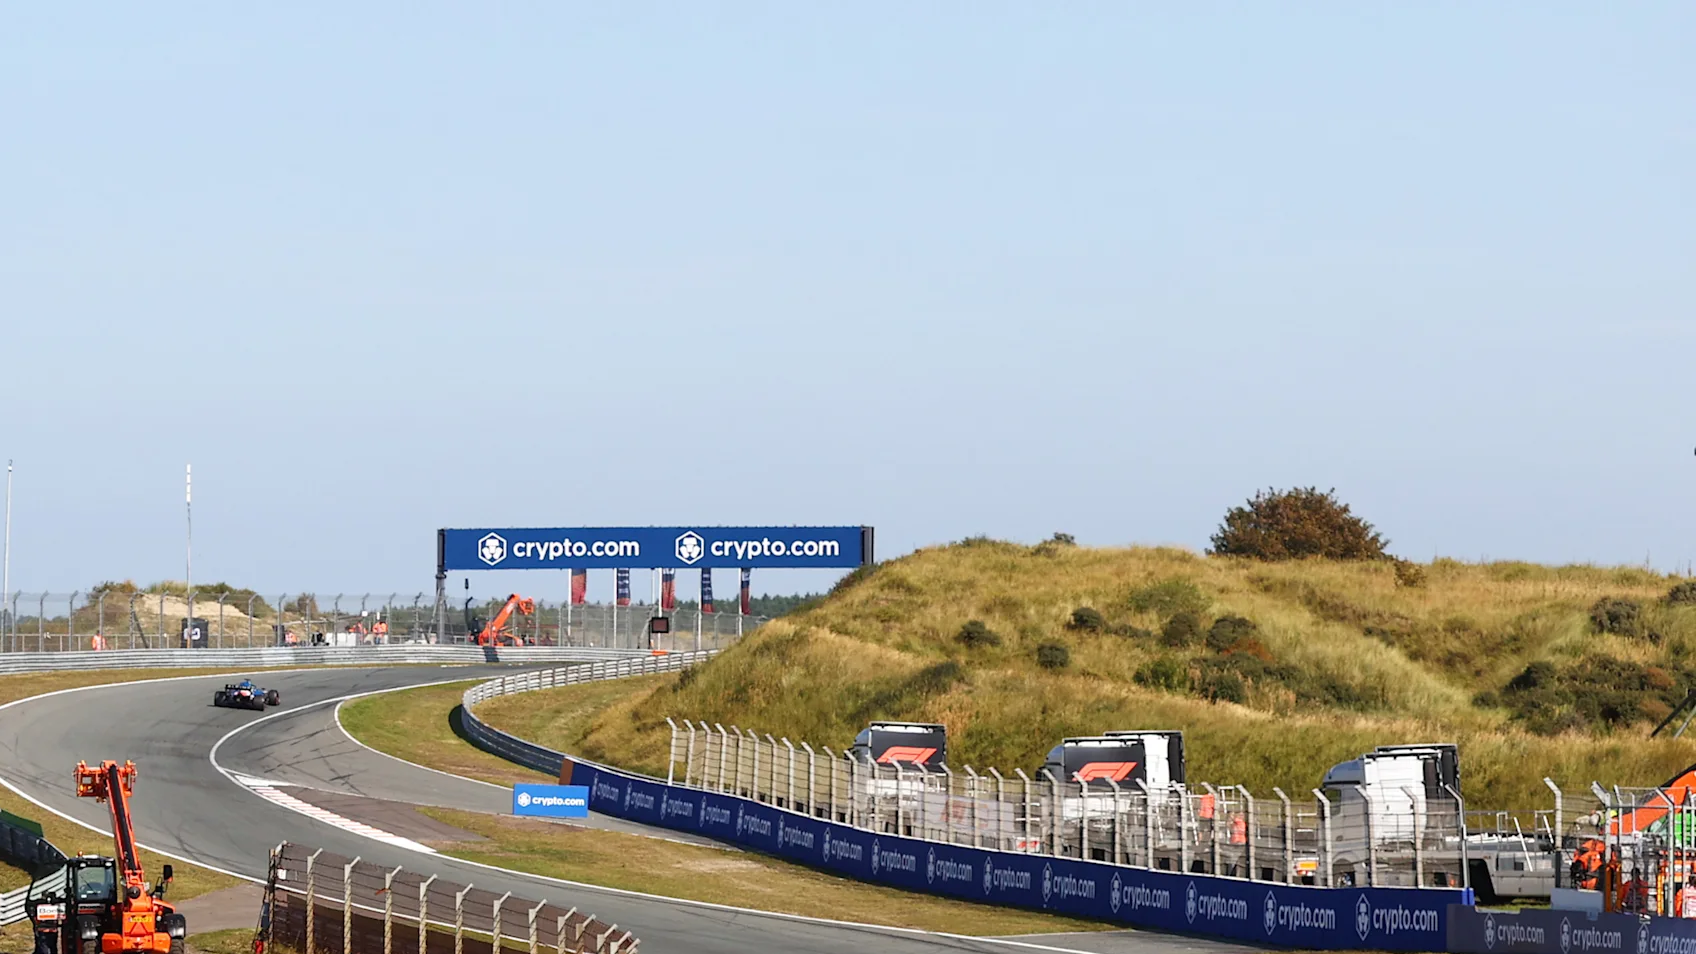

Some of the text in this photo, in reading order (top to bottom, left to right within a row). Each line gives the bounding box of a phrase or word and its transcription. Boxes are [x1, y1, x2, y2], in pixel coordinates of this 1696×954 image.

[513, 538, 640, 560] crypto.com
[711, 536, 839, 560] crypto.com
[532, 796, 585, 806] crypto.com
[831, 837, 863, 860] crypto.com
[880, 849, 916, 872] crypto.com
[936, 858, 972, 882] crypto.com
[993, 867, 1031, 891] crypto.com
[1053, 874, 1095, 899] crypto.com
[1123, 884, 1170, 910] crypto.com
[1198, 893, 1248, 920] crypto.com
[1278, 902, 1336, 932] crypto.com
[1373, 904, 1438, 935] crypto.com
[1497, 924, 1545, 945] crypto.com
[1572, 927, 1622, 951] crypto.com
